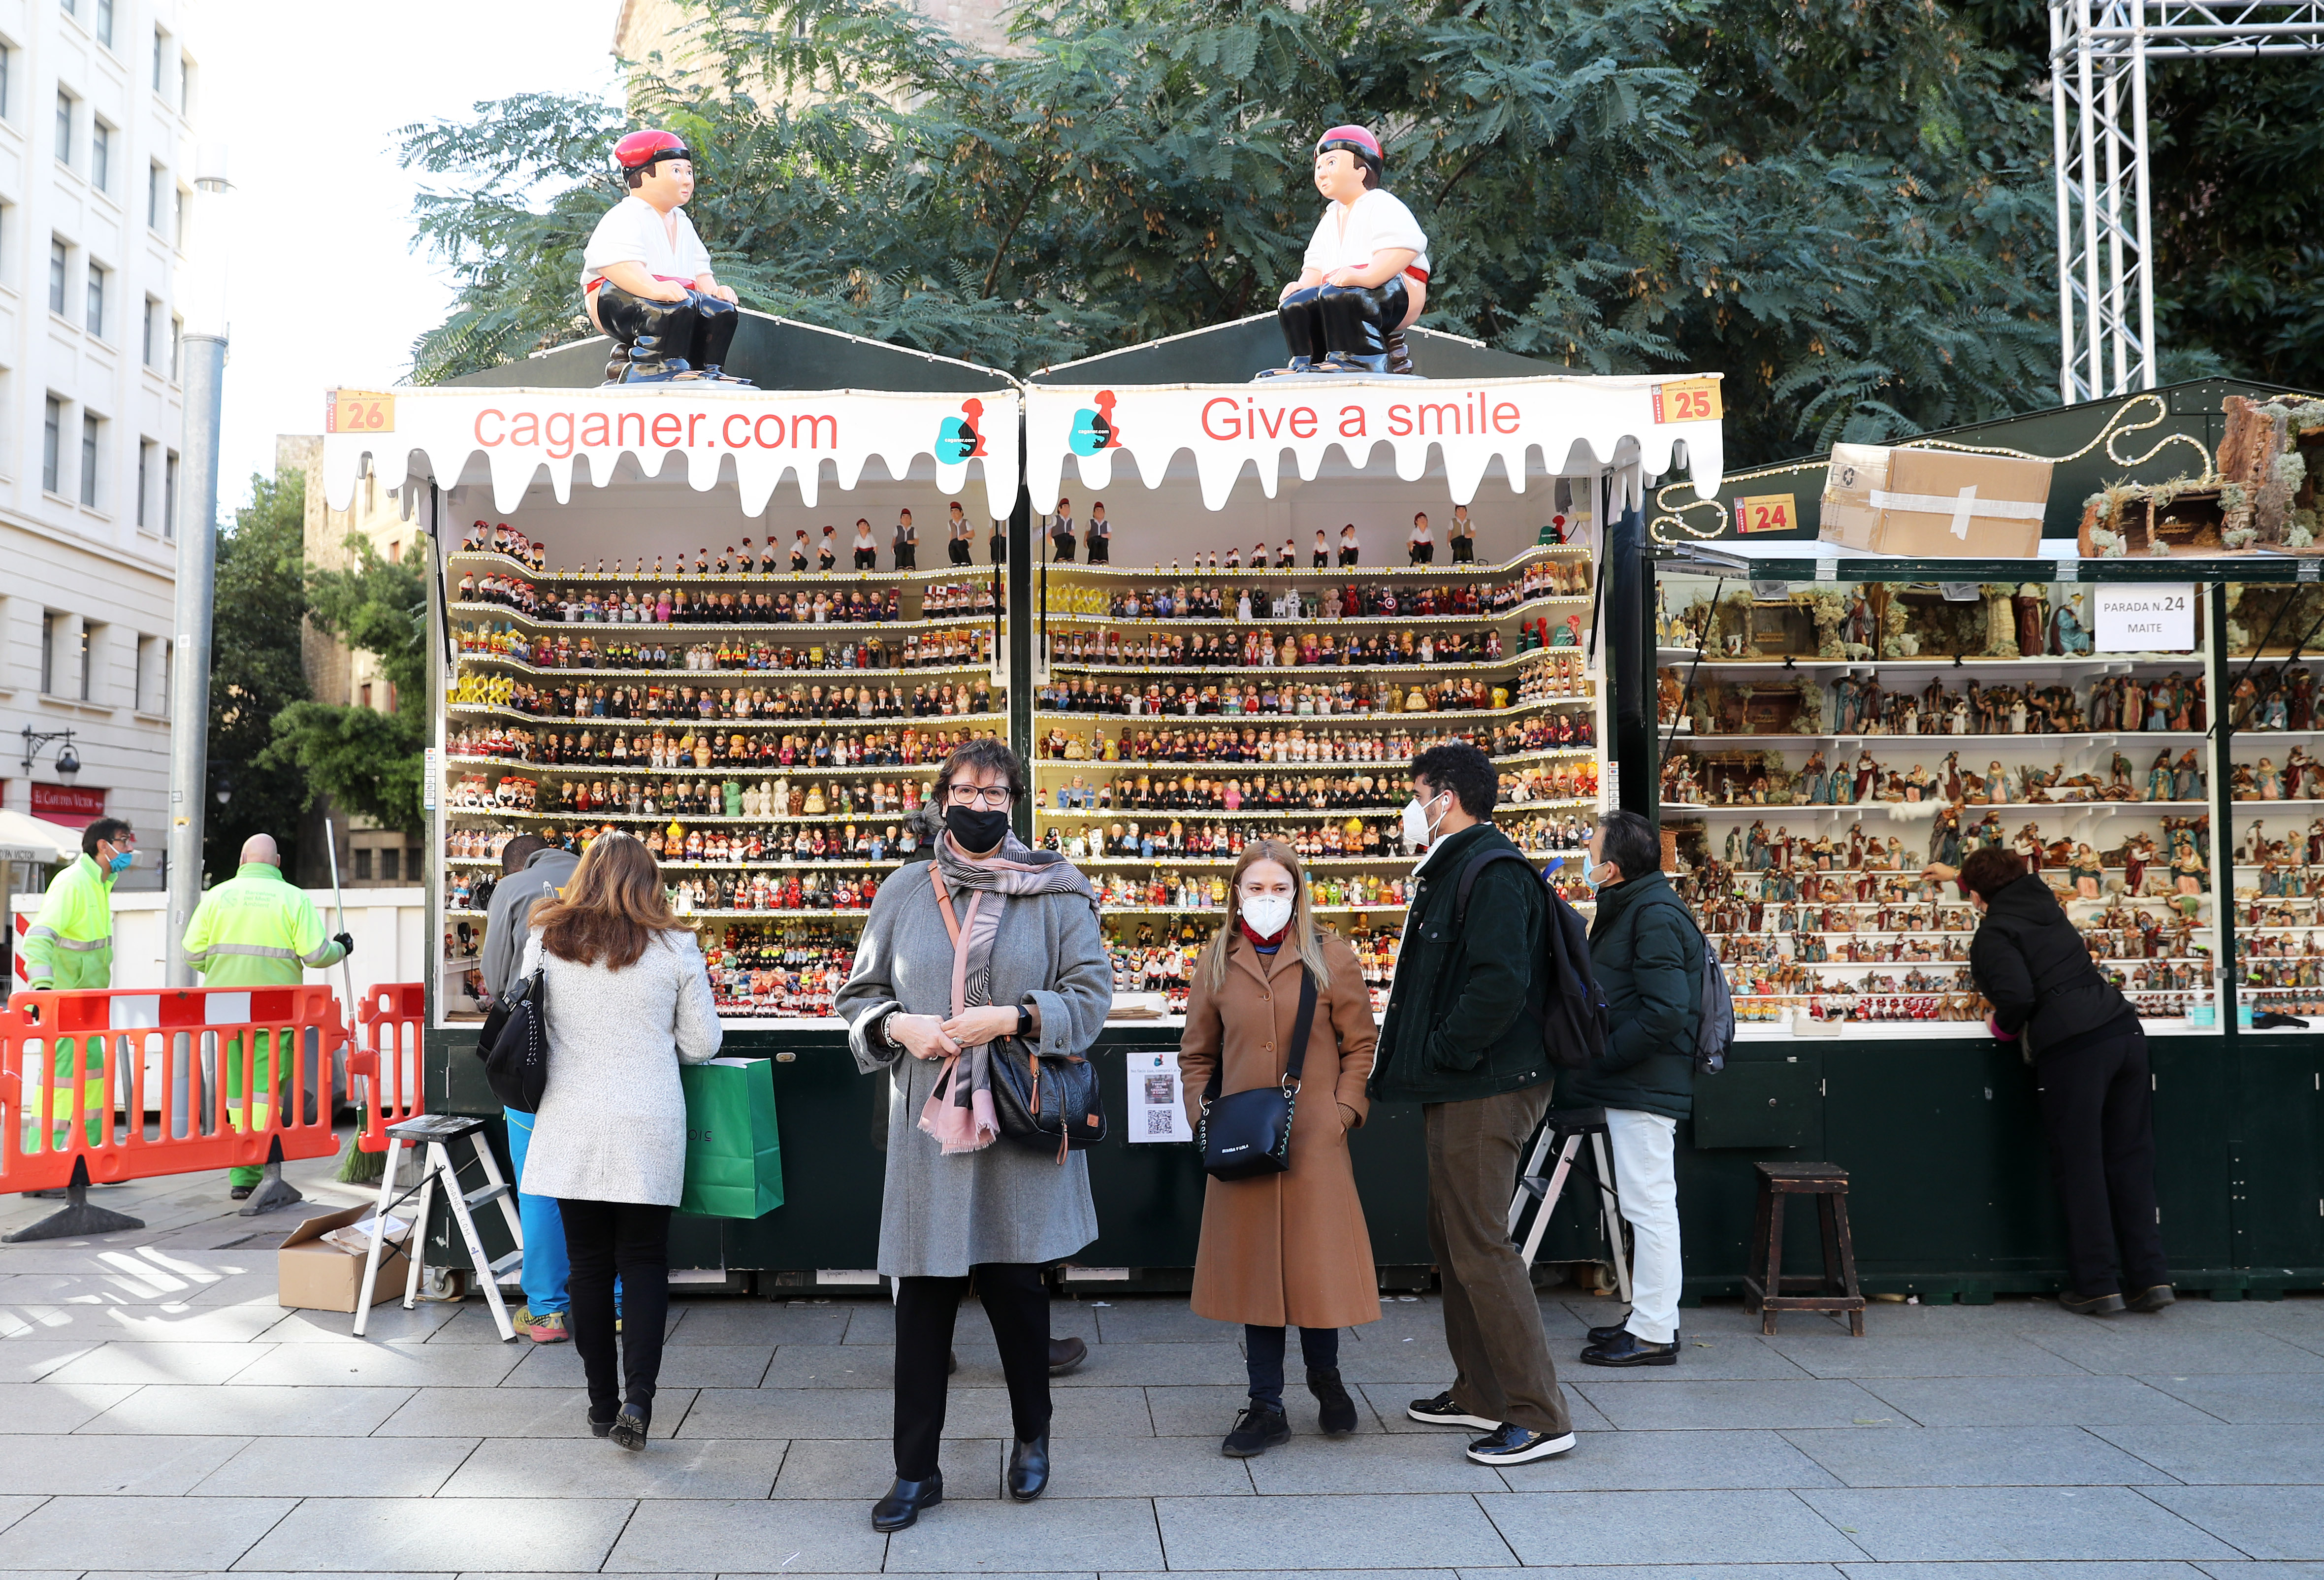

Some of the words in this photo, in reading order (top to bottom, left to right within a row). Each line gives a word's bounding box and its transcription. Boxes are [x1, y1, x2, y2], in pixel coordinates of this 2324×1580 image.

[348, 402, 384, 428] 26
[1201, 397, 1318, 441] Give
[1339, 405, 1367, 437] a
[1388, 392, 1520, 436] smile
[1675, 391, 1711, 419] 25
[1755, 505, 1787, 529] 24
[2104, 602, 2149, 612] PARADA
[2152, 596, 2185, 612] N.24
[2128, 624, 2162, 633] MAITE
[14, 850, 36, 859] VICTOR
